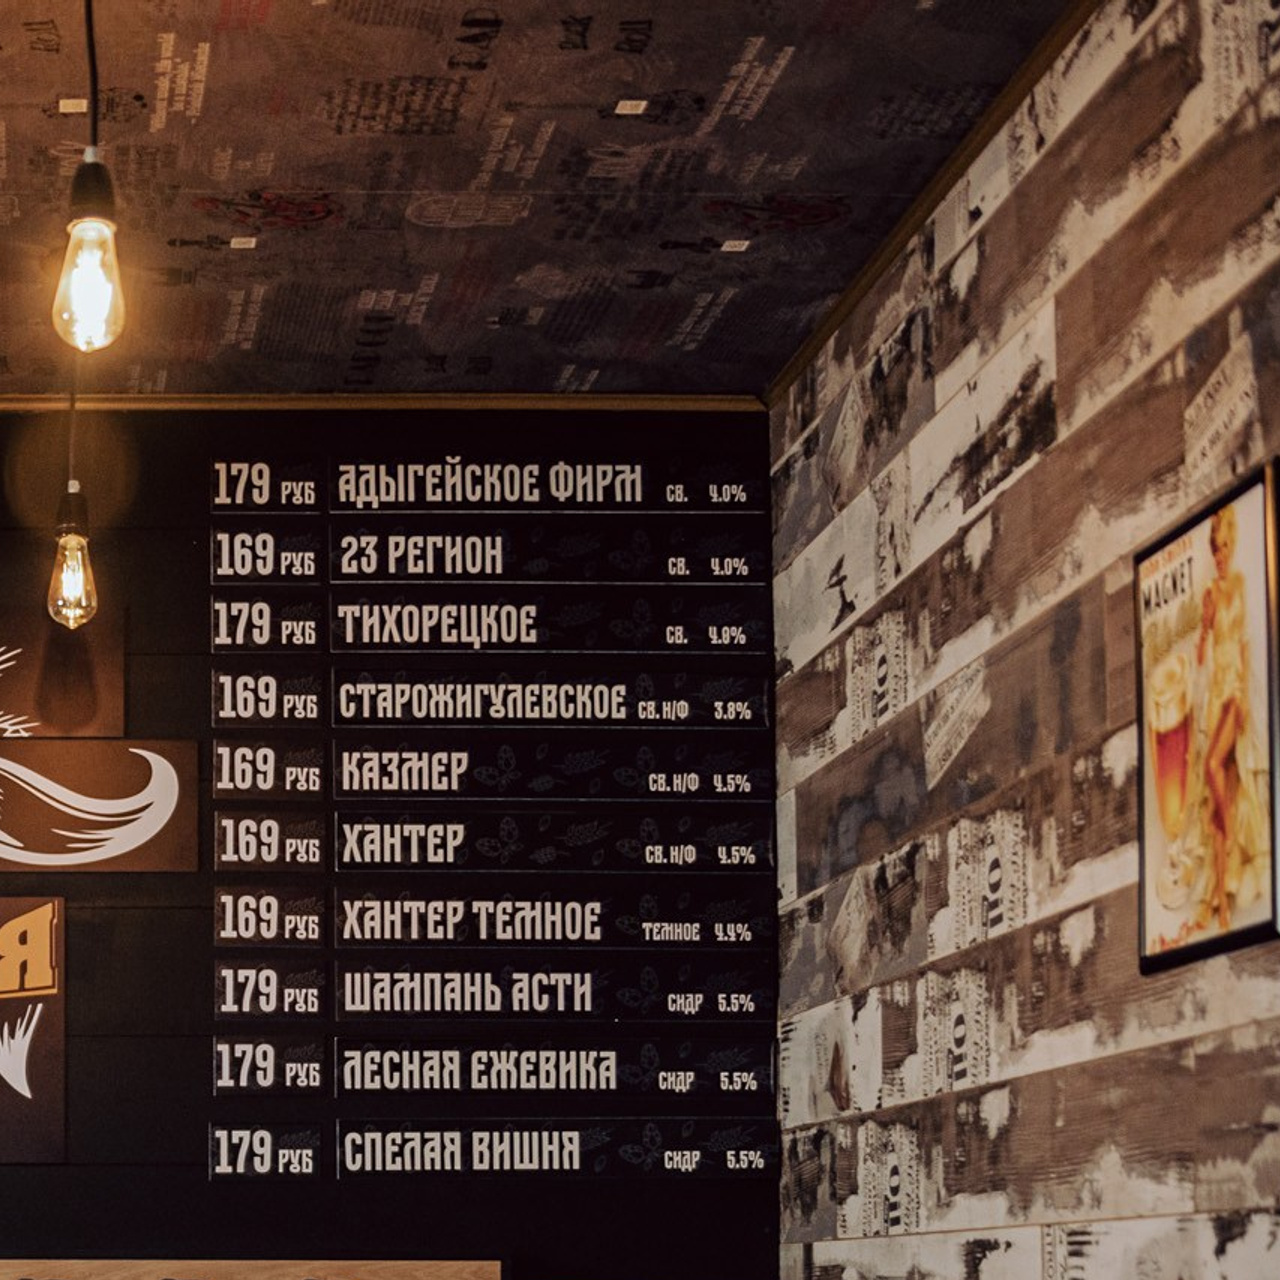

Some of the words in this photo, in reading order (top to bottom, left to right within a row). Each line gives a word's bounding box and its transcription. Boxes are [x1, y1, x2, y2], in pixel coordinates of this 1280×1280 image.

[213, 463, 270, 505] 179
[281, 481, 315, 504] РУБ
[338, 456, 540, 509] АДЫГЕЙСКОЕ
[549, 462, 642, 502] ФИРМ
[666, 485, 688, 502] СВ.
[709, 484, 746, 502] 4.0%
[217, 533, 274, 576] 169
[281, 552, 315, 575] РУБ
[340, 536, 377, 574] 23
[388, 536, 503, 575] РЕГИОН
[668, 558, 690, 576] СВ.
[711, 557, 748, 576] 4.0%
[1142, 555, 1195, 620] MAGNET
[213, 602, 270, 645] 179
[281, 621, 316, 645] РУБ
[338, 605, 537, 649] ТИХОРЕЦКОЕ
[666, 627, 688, 644] СВ.
[219, 675, 277, 718] 169
[283, 695, 318, 718] РУБ
[339, 683, 626, 719] СТАРОЖИГУЛЕВСКОЕ
[714, 702, 752, 720] 3.8%
[217, 747, 274, 791] 169
[285, 767, 320, 790] РУБ
[341, 752, 468, 791] КАЗМЕР
[713, 774, 751, 793] 4.5%
[221, 819, 279, 862] 169
[285, 839, 320, 862] РУБ
[342, 824, 465, 863] ХАНТЕР
[718, 846, 756, 864] 4.5%
[220, 895, 279, 939] 169
[284, 916, 319, 938] РУБ
[342, 901, 465, 940] ХАНТЕР
[472, 900, 602, 940] ТЕМНОЕ
[642, 923, 700, 942] ТЕМНОЕ
[715, 923, 752, 942] 4.4%
[221, 969, 278, 1012] 179
[284, 988, 318, 1011] РУБ
[344, 973, 502, 1012] ШАМПАНЬ
[512, 973, 592, 1011] АСТИ
[667, 994, 703, 1015] СИДР
[718, 994, 755, 1012] 5.5%
[217, 1043, 274, 1087] 179
[285, 1063, 320, 1086] РУБ
[343, 1050, 461, 1089] ЛЕСНАЯ
[471, 1050, 617, 1089] ЕЖЕВИКА
[659, 1072, 695, 1092] СИДР
[720, 1072, 757, 1091] 5.5%
[215, 1130, 272, 1173] 179
[278, 1149, 313, 1173] РУБ
[344, 1131, 462, 1171] СПЕЛАЯ
[472, 1131, 580, 1170] ВИШНЯ
[664, 1151, 700, 1171] СИДР
[726, 1151, 765, 1169] 5.5%
